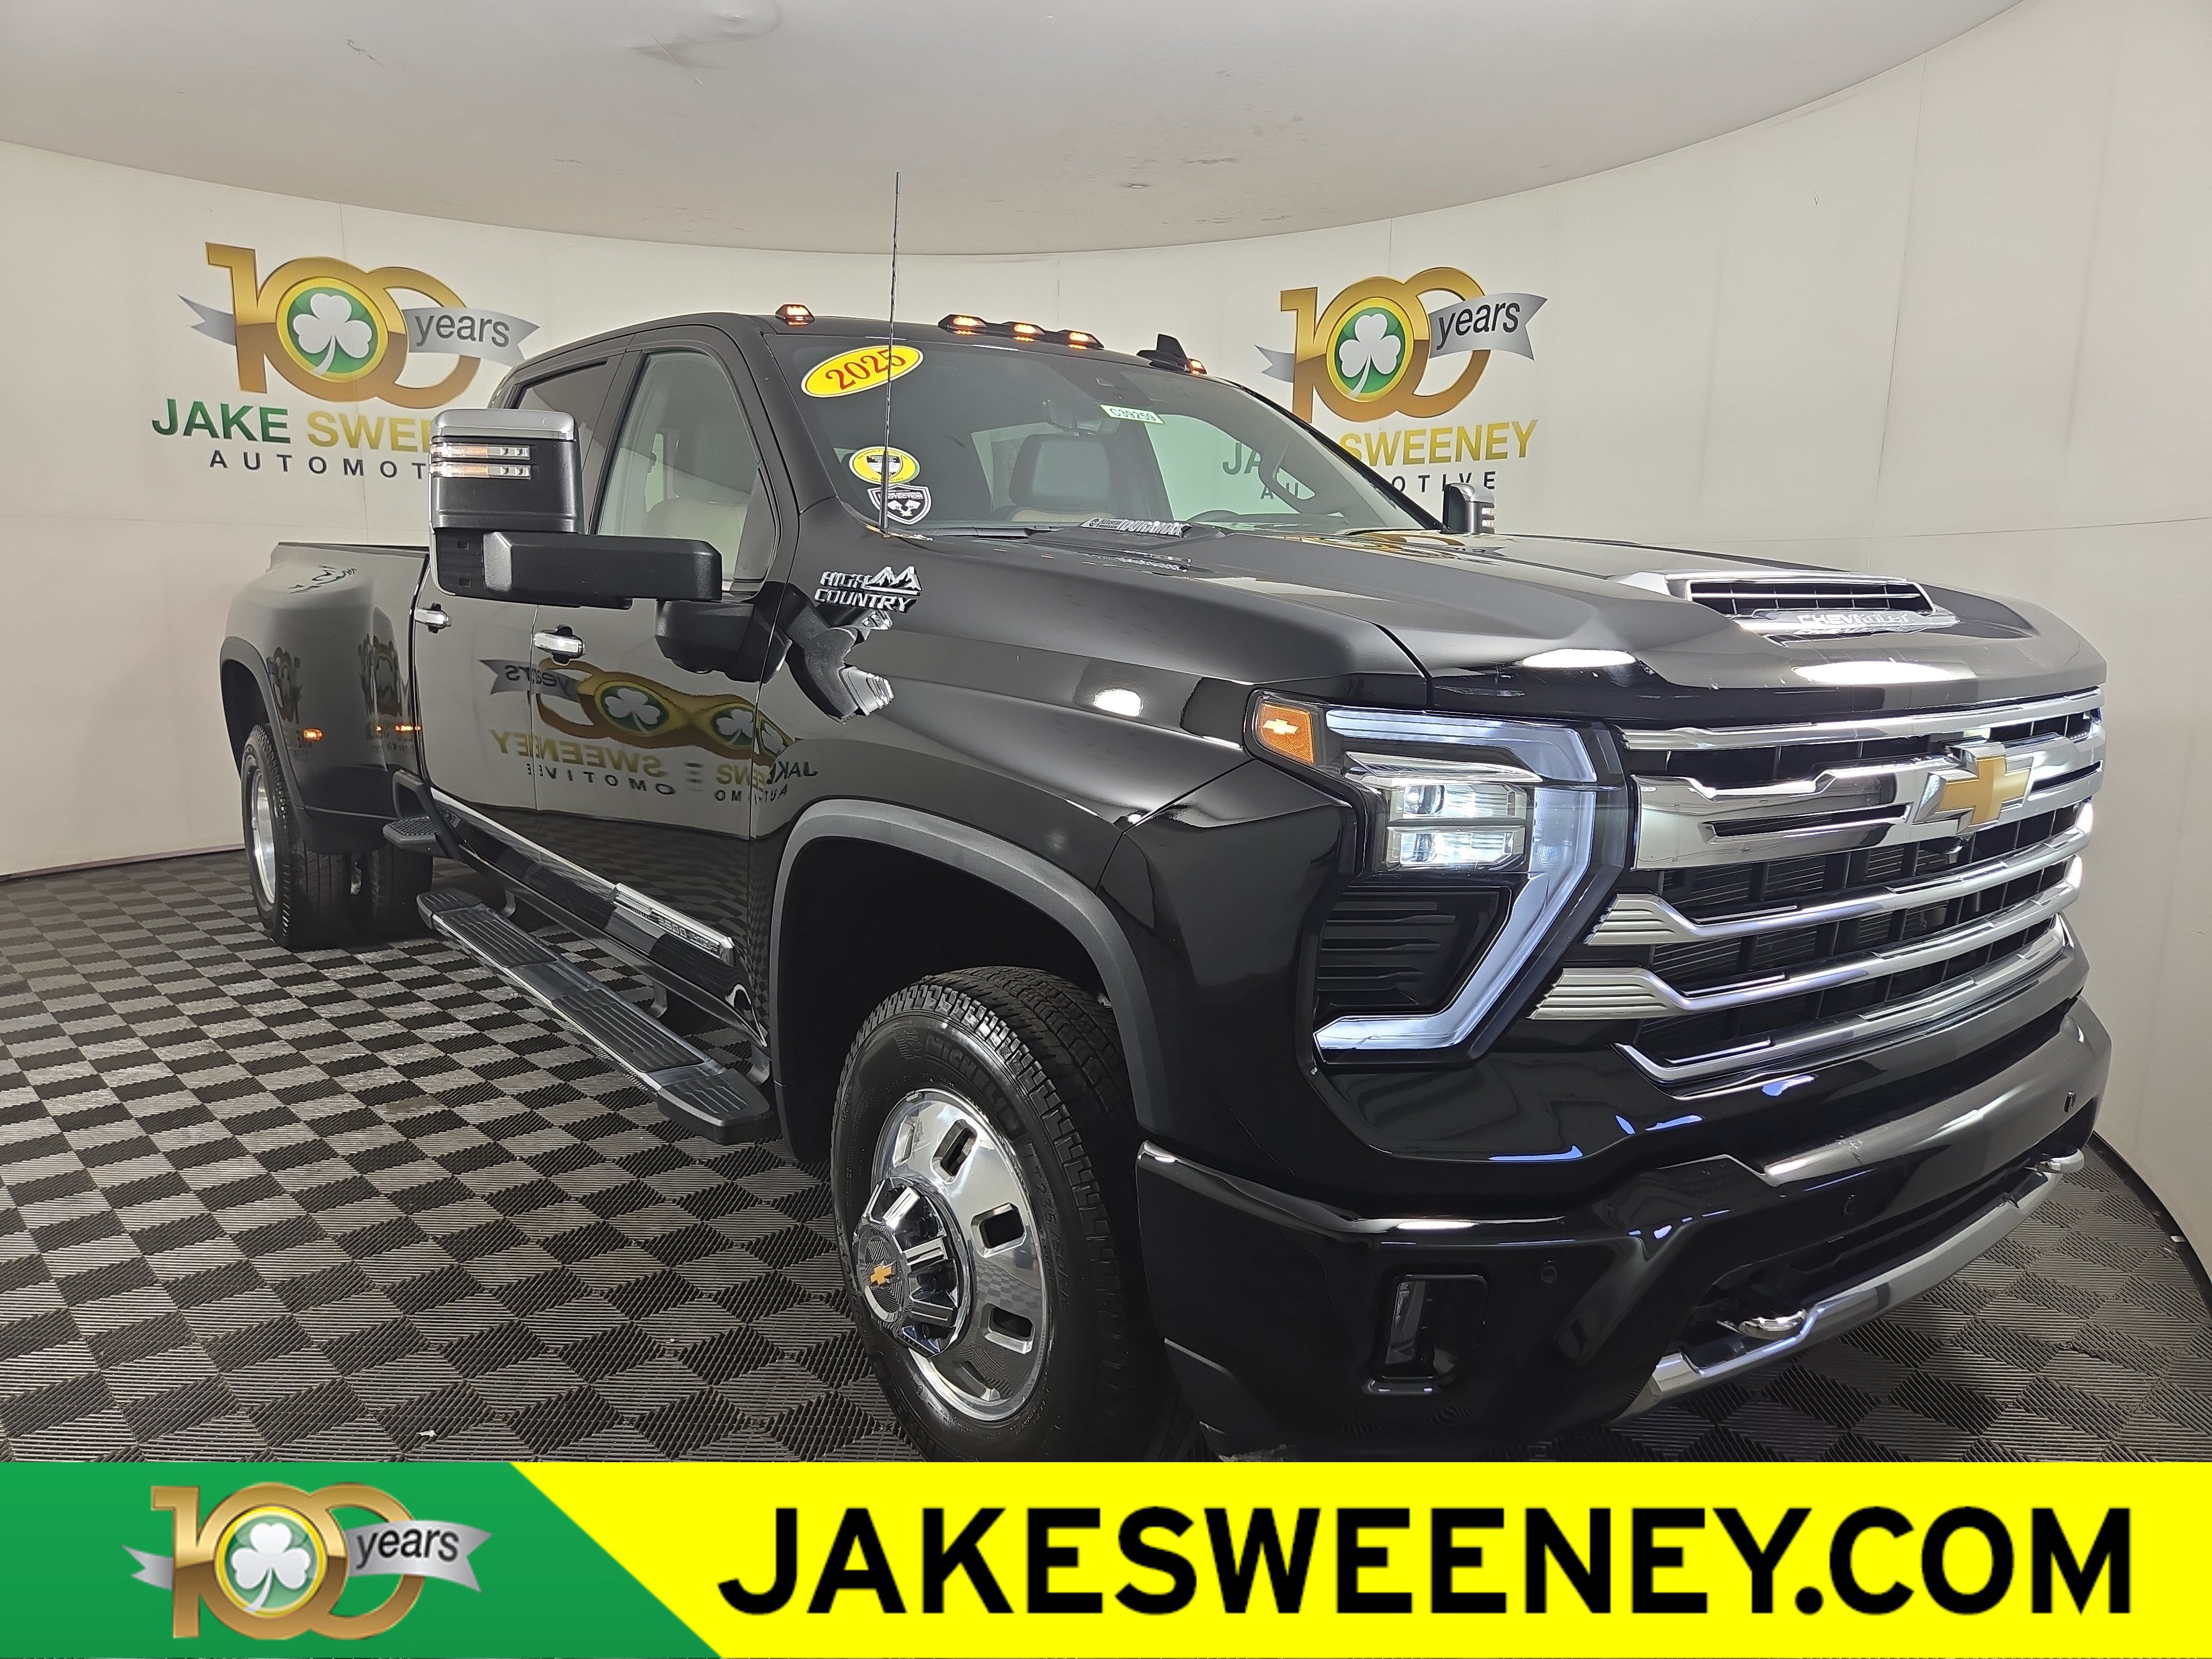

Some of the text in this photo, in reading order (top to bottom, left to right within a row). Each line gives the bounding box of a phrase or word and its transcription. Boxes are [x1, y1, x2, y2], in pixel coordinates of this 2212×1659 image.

[415, 313, 511, 348] years
[1436, 301, 1520, 351] years
[825, 349, 906, 390] 2025
[152, 398, 291, 443] JAKE
[1110, 408, 1156, 421] C39259
[1340, 419, 1539, 467] SWEENEY
[209, 449, 427, 480] AUTOMOT
[819, 571, 871, 589] HIGH
[814, 588, 918, 612] COUNTRY
[1797, 613, 1914, 624] CHEVROLET
[925, 1034, 1021, 1134] MICHELIN
